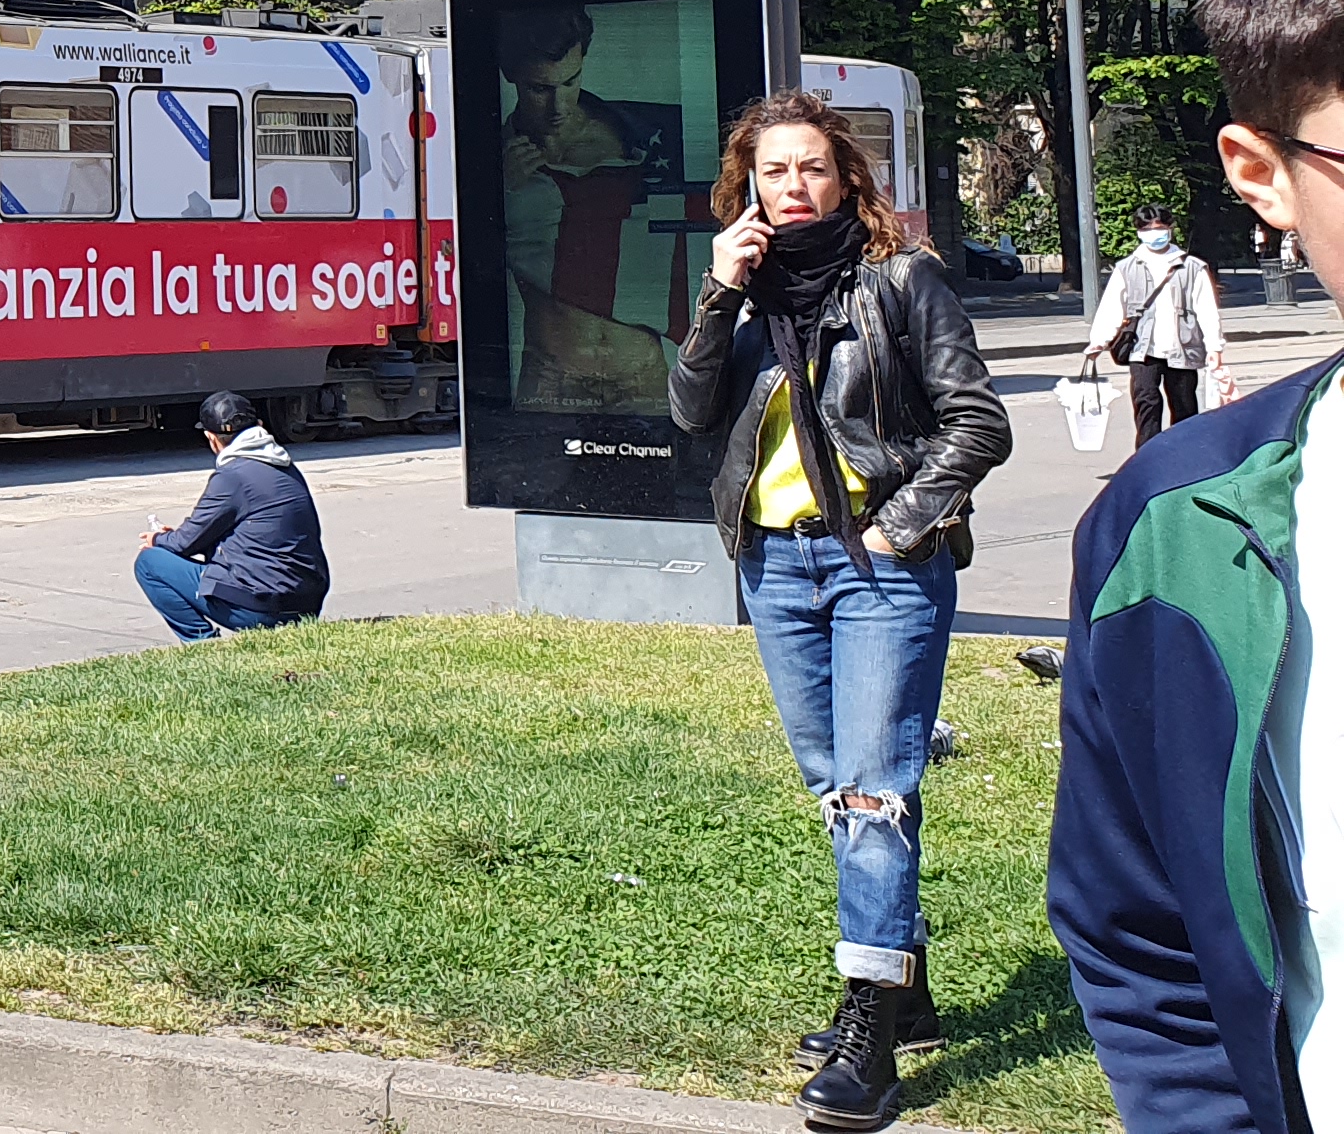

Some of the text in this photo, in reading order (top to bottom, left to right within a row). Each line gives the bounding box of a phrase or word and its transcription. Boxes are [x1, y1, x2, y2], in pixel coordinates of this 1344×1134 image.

[53, 43, 192, 64] www.walliance.it
[118, 68, 143, 82] 4974
[153, 250, 199, 315] la
[213, 253, 298, 313] tua
[583, 441, 672, 459] Clear Channel
